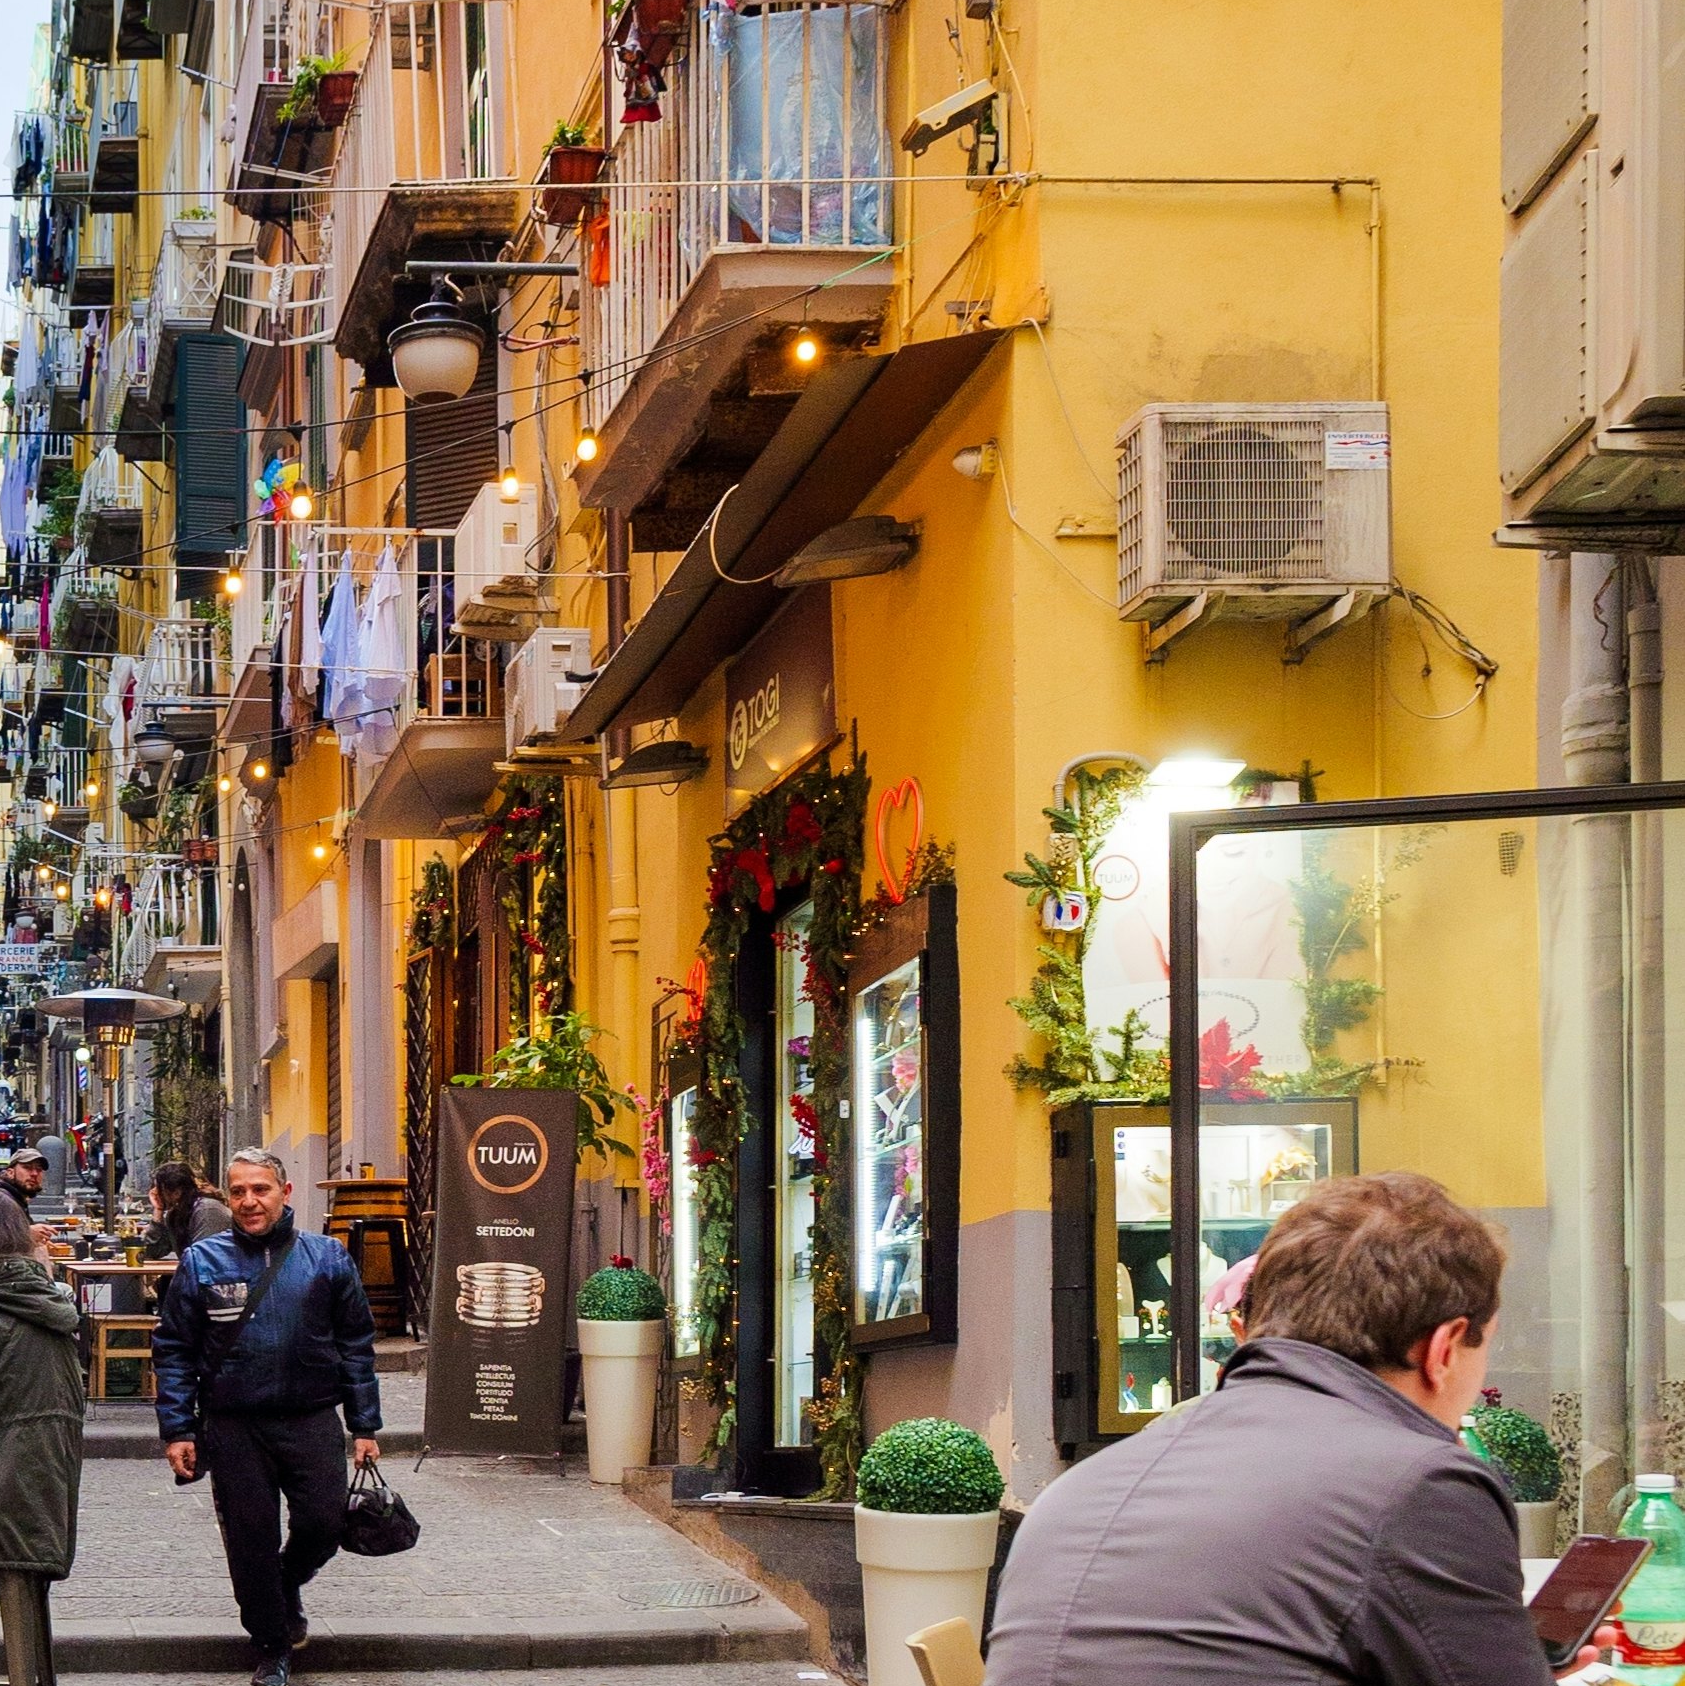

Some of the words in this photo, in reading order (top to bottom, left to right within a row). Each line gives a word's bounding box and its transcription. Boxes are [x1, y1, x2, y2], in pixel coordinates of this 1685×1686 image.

[747, 672, 780, 735] TOGI
[1097, 873, 1134, 884] TUUM
[478, 1146, 537, 1165] TUUM
[476, 1226, 535, 1237] SETTEDONI
[476, 1388, 514, 1396] FORTITUDO
